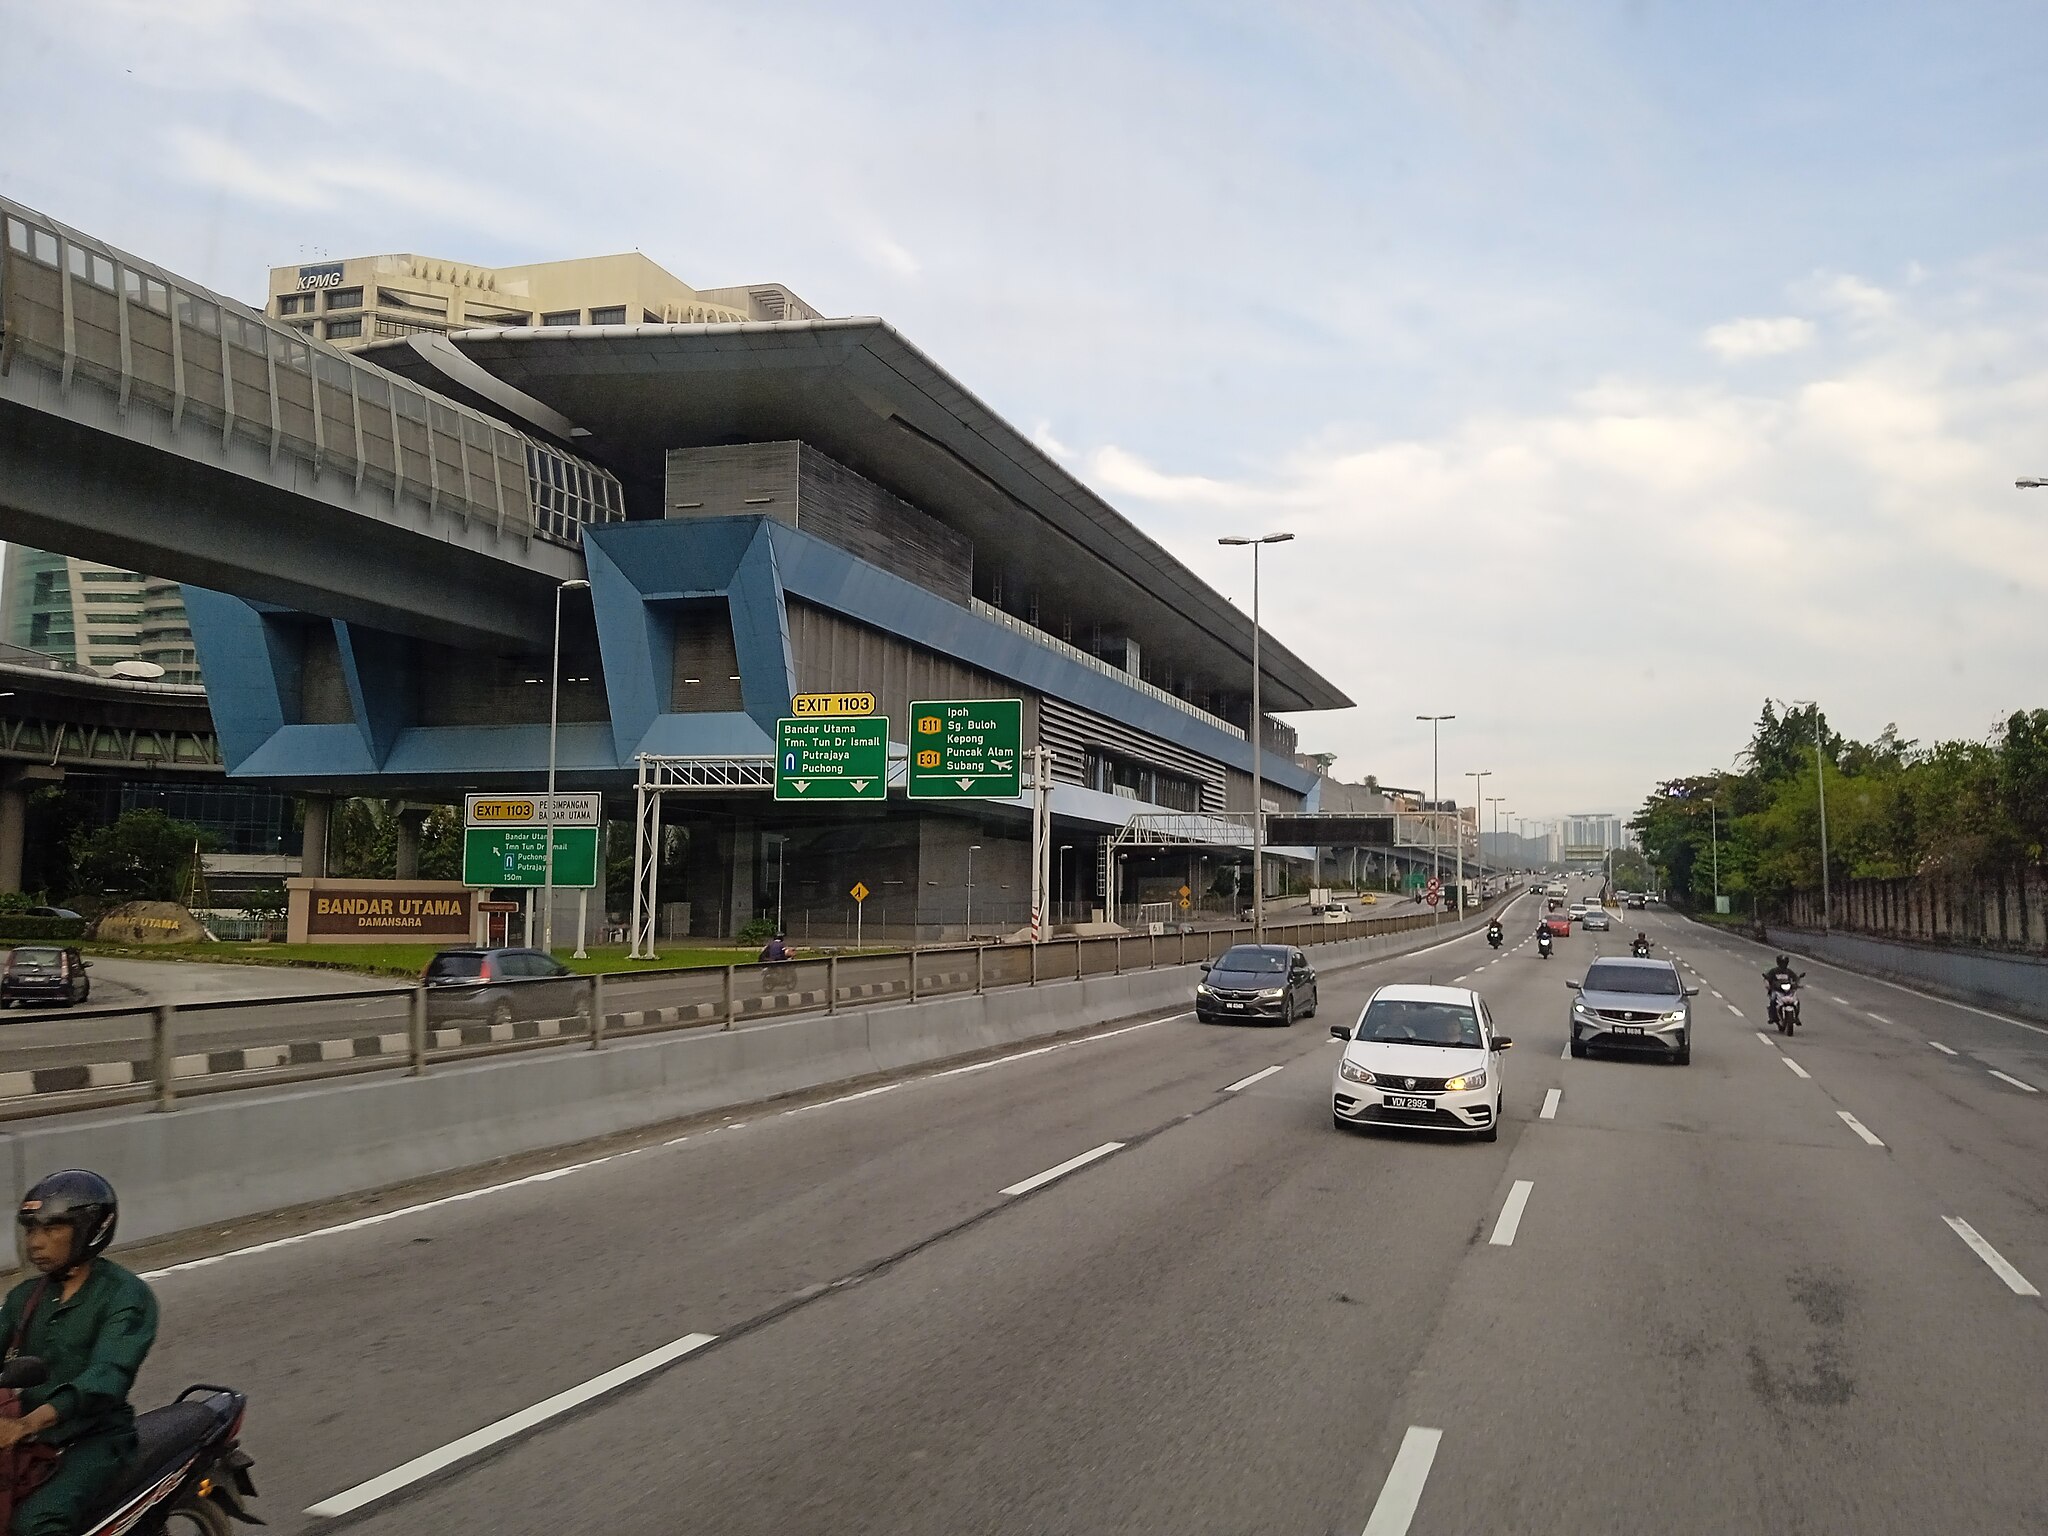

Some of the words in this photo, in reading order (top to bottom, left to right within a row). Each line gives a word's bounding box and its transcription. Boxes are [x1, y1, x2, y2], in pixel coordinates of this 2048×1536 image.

[296, 272, 341, 290] KPMG
[796, 698, 831, 712] EXIT
[837, 697, 870, 711] 1103
[947, 707, 969, 719] Ipoh
[784, 724, 820, 734] Bandar
[823, 723, 856, 734] Utama
[922, 720, 938, 731] E11
[947, 721, 964, 731] Sg.
[967, 720, 997, 730] Buloh
[784, 737, 808, 747] Tmn.
[812, 737, 831, 747] Tun
[834, 736, 847, 747] Dr
[850, 736, 880, 747] Ismail
[946, 734, 984, 745] Kepong
[802, 750, 850, 762] Putrajaya
[946, 747, 983, 758] Puncak
[987, 746, 1014, 757] Alam
[919, 753, 938, 765] E31
[801, 763, 844, 775] Puchong
[946, 761, 985, 772] Subang
[539, 800, 589, 810] PESIMPANGAN
[476, 805, 502, 817] EXIT
[506, 805, 531, 816] 1103
[538, 811, 565, 820] BADAR
[568, 811, 591, 820] UTAMA
[505, 833, 530, 841] Bandar
[505, 843, 520, 851] Tmn
[522, 843, 535, 851] Tun
[536, 843, 546, 851] Dr
[518, 853, 547, 863] Puchong
[517, 863, 547, 872] Putrajay
[503, 873, 522, 882] 150m
[316, 898, 393, 915] BANDAR
[398, 898, 462, 915] UTAMA
[140, 918, 180, 930] UTAMA
[357, 917, 423, 928] DAMANSARA
[1391, 1097, 1406, 1107] VDV
[1407, 1098, 1428, 1109] 2992
